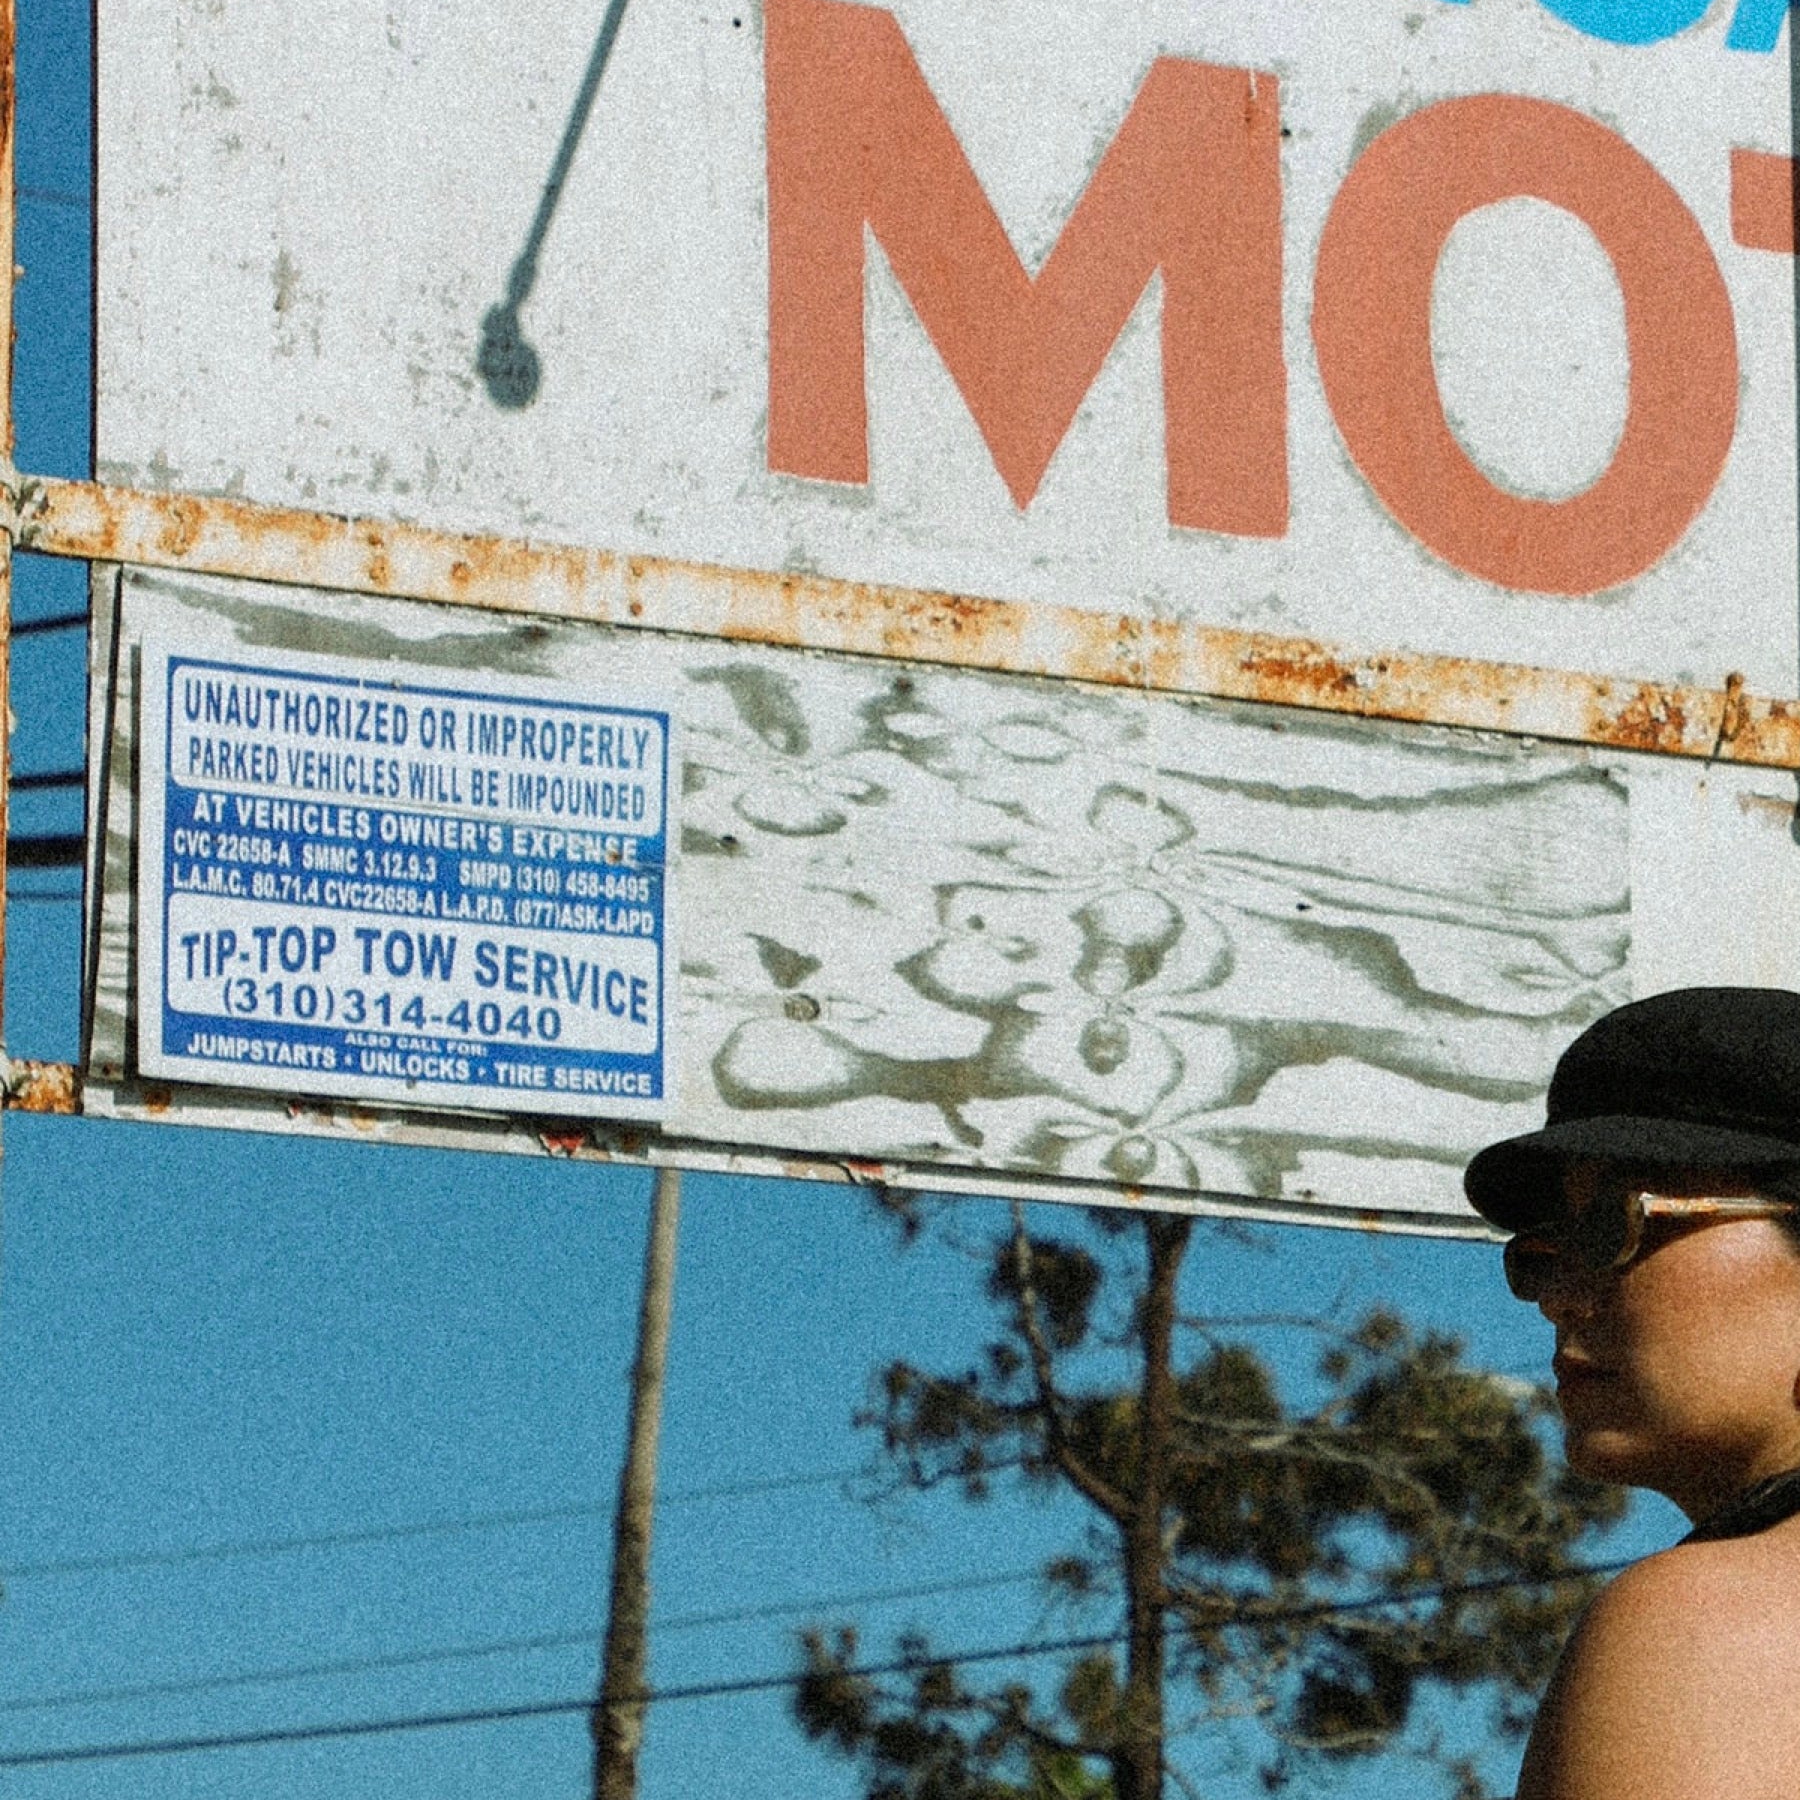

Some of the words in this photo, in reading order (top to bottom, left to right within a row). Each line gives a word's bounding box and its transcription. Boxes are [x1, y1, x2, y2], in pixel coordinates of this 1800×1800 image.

[185, 678, 409, 746] UNAUTHORIZED
[419, 707, 457, 751] OR
[467, 711, 649, 769] IMPROPERLY
[189, 736, 279, 783] PARKED
[287, 748, 400, 797] VEHICLES
[408, 761, 462, 803] WILL
[471, 767, 499, 807] BE
[508, 773, 645, 821] IMPOUNDED
[173, 827, 211, 859] CVC
[216, 833, 291, 868] 22658-A
[302, 842, 359, 875] SMMC
[459, 859, 512, 890] SMPD
[515, 864, 561, 896] (310)
[566, 870, 650, 902] 458-8495
[193, 794, 227, 824] AT
[235, 796, 372, 841] VEHICLES
[380, 812, 503, 853] OWNER'S
[512, 828, 638, 867] EXPENSE
[173, 862, 247, 897] L.A.M.C.
[441, 890, 509, 922] L.A.P.D.
[181, 926, 337, 980] TIP-TOP
[353, 927, 457, 982] TOW
[474, 939, 648, 1025] SERVICE
[188, 1032, 337, 1070] JUMPSTARTS
[360, 1049, 471, 1082] UNLOCKS
[493, 1061, 548, 1089] TIRE
[553, 1066, 652, 1096] SERVICE
[344, 1032, 391, 1048] ALSO
[396, 1035, 441, 1053] CALL
[446, 1041, 488, 1056] FOR:
